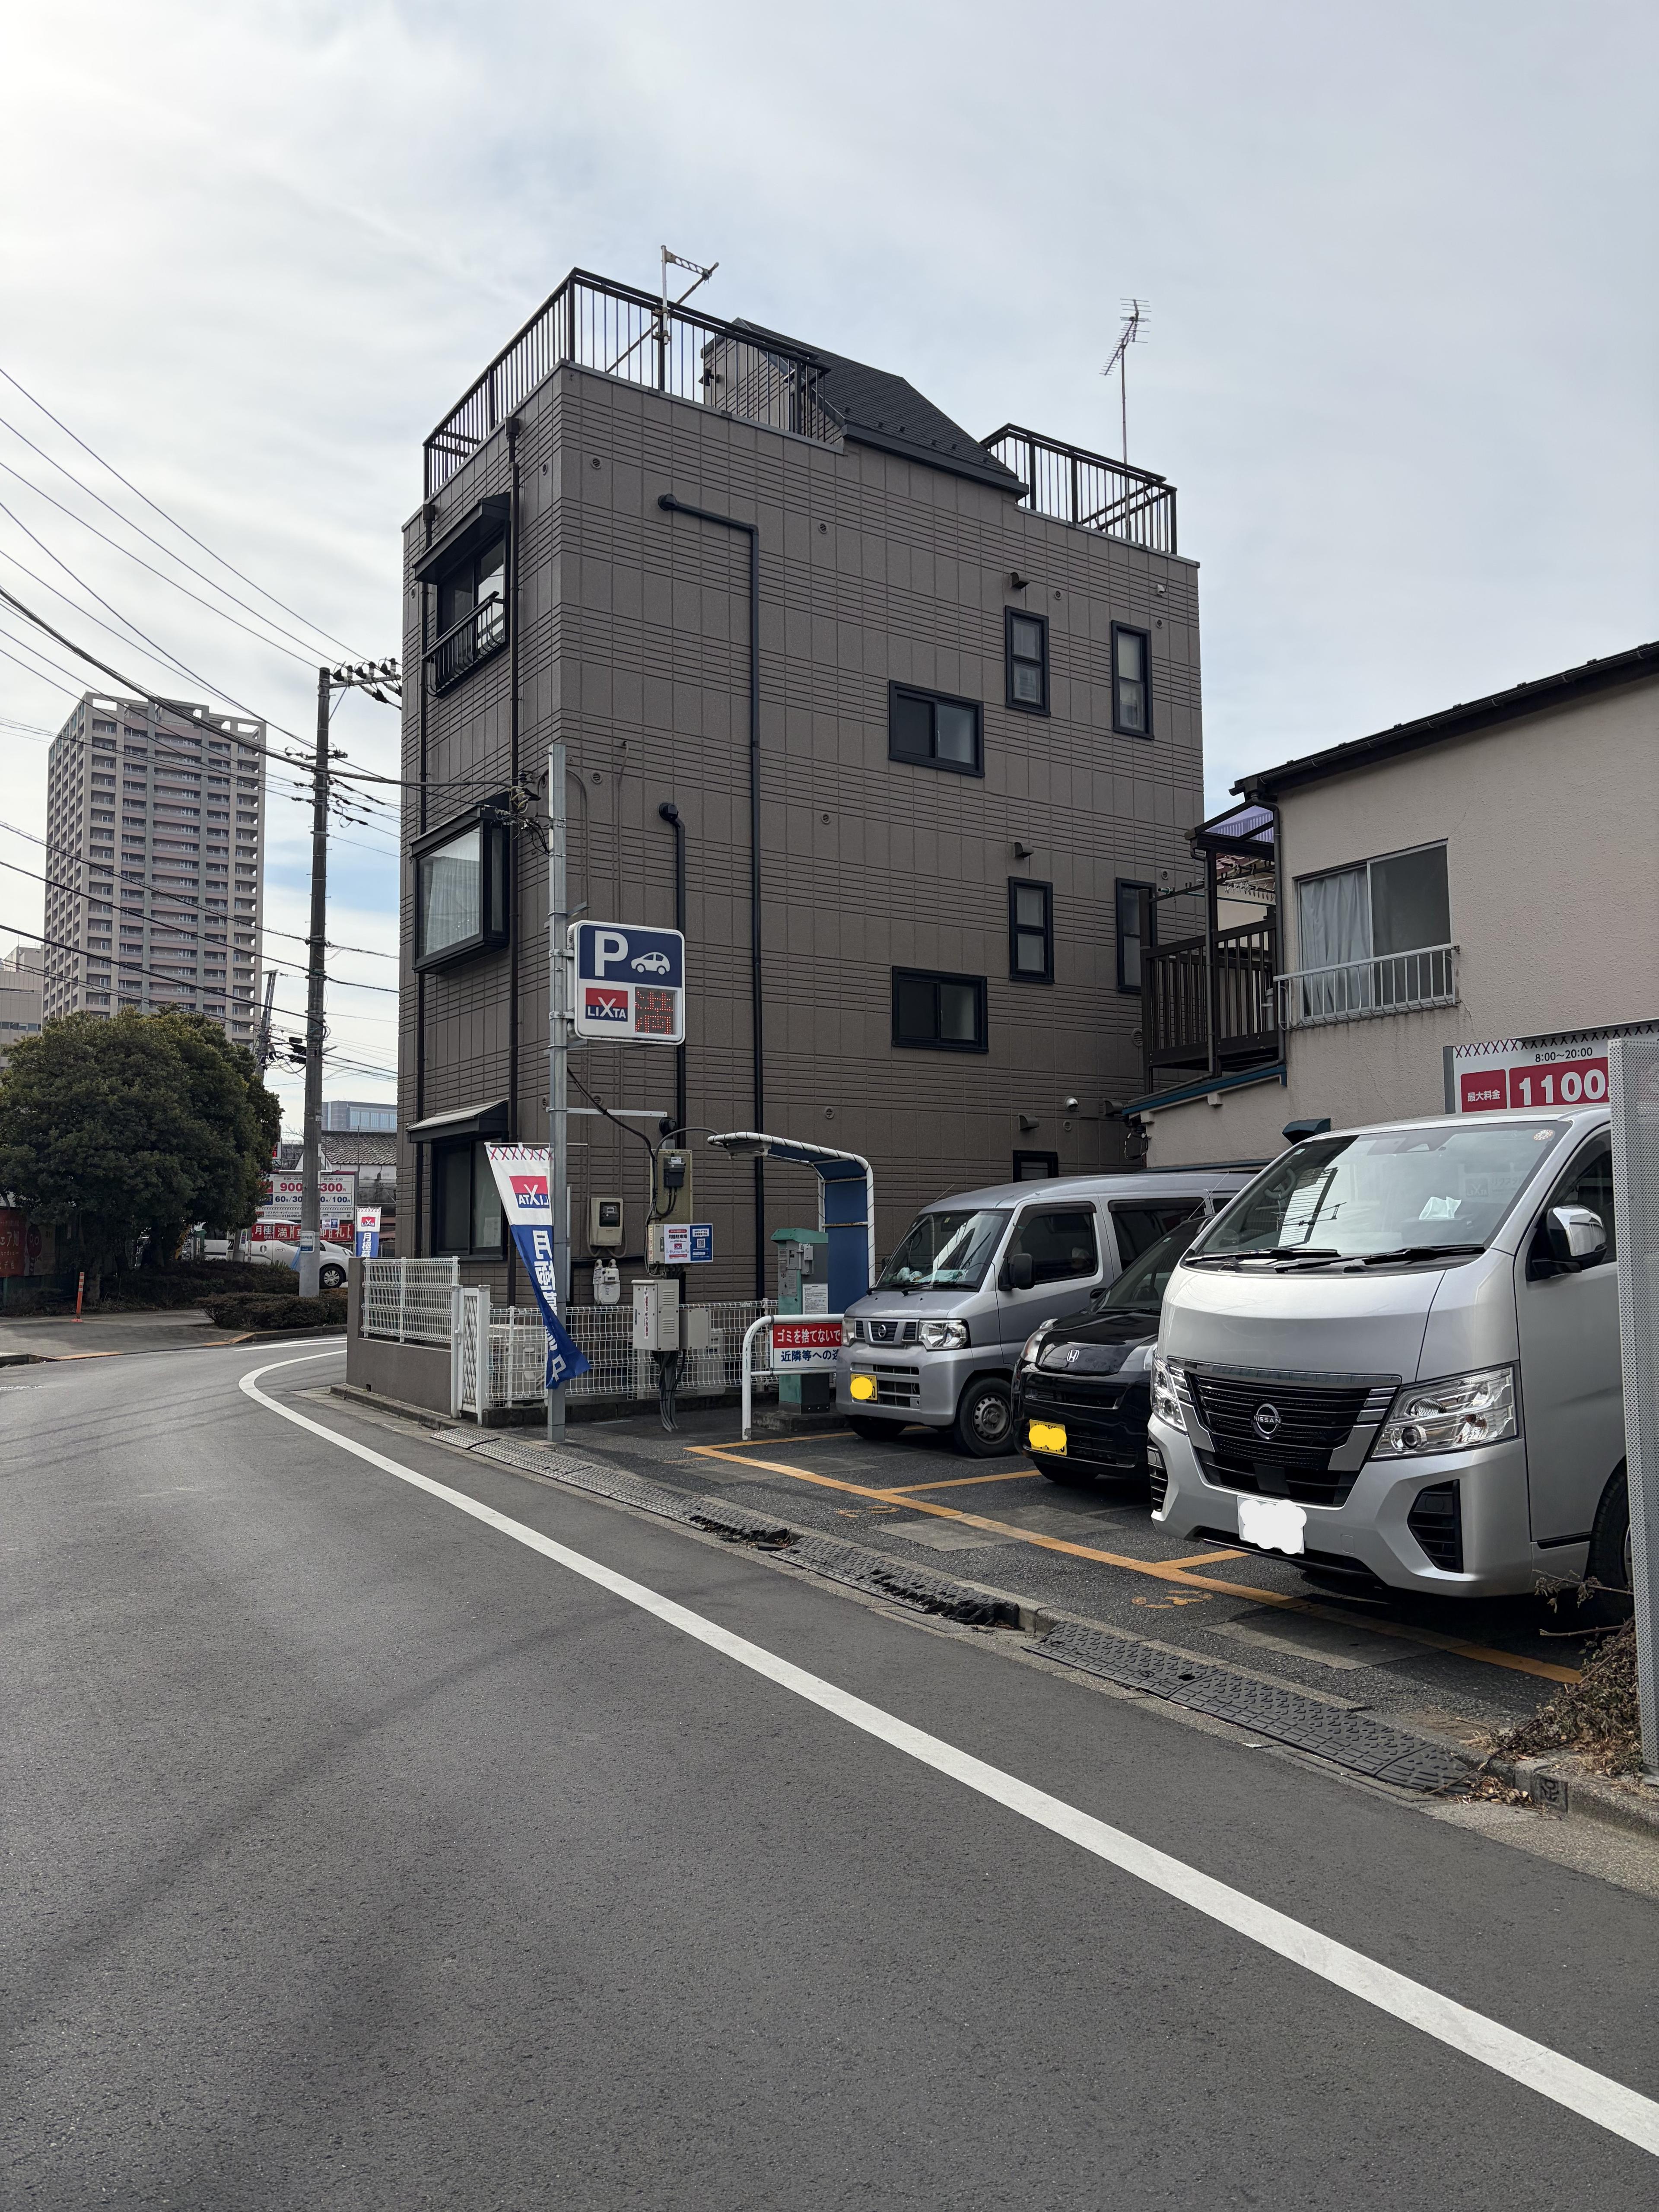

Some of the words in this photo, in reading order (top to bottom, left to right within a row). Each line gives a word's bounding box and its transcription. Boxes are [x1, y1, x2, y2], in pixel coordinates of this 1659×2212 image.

[595, 930, 628, 977] P
[588, 997, 626, 1019] LIXTA
[1467, 1089, 1500, 1102] 最大料金
[1519, 1069, 1605, 1106] 1100
[1254, 1415, 1281, 1424] NISSAN
